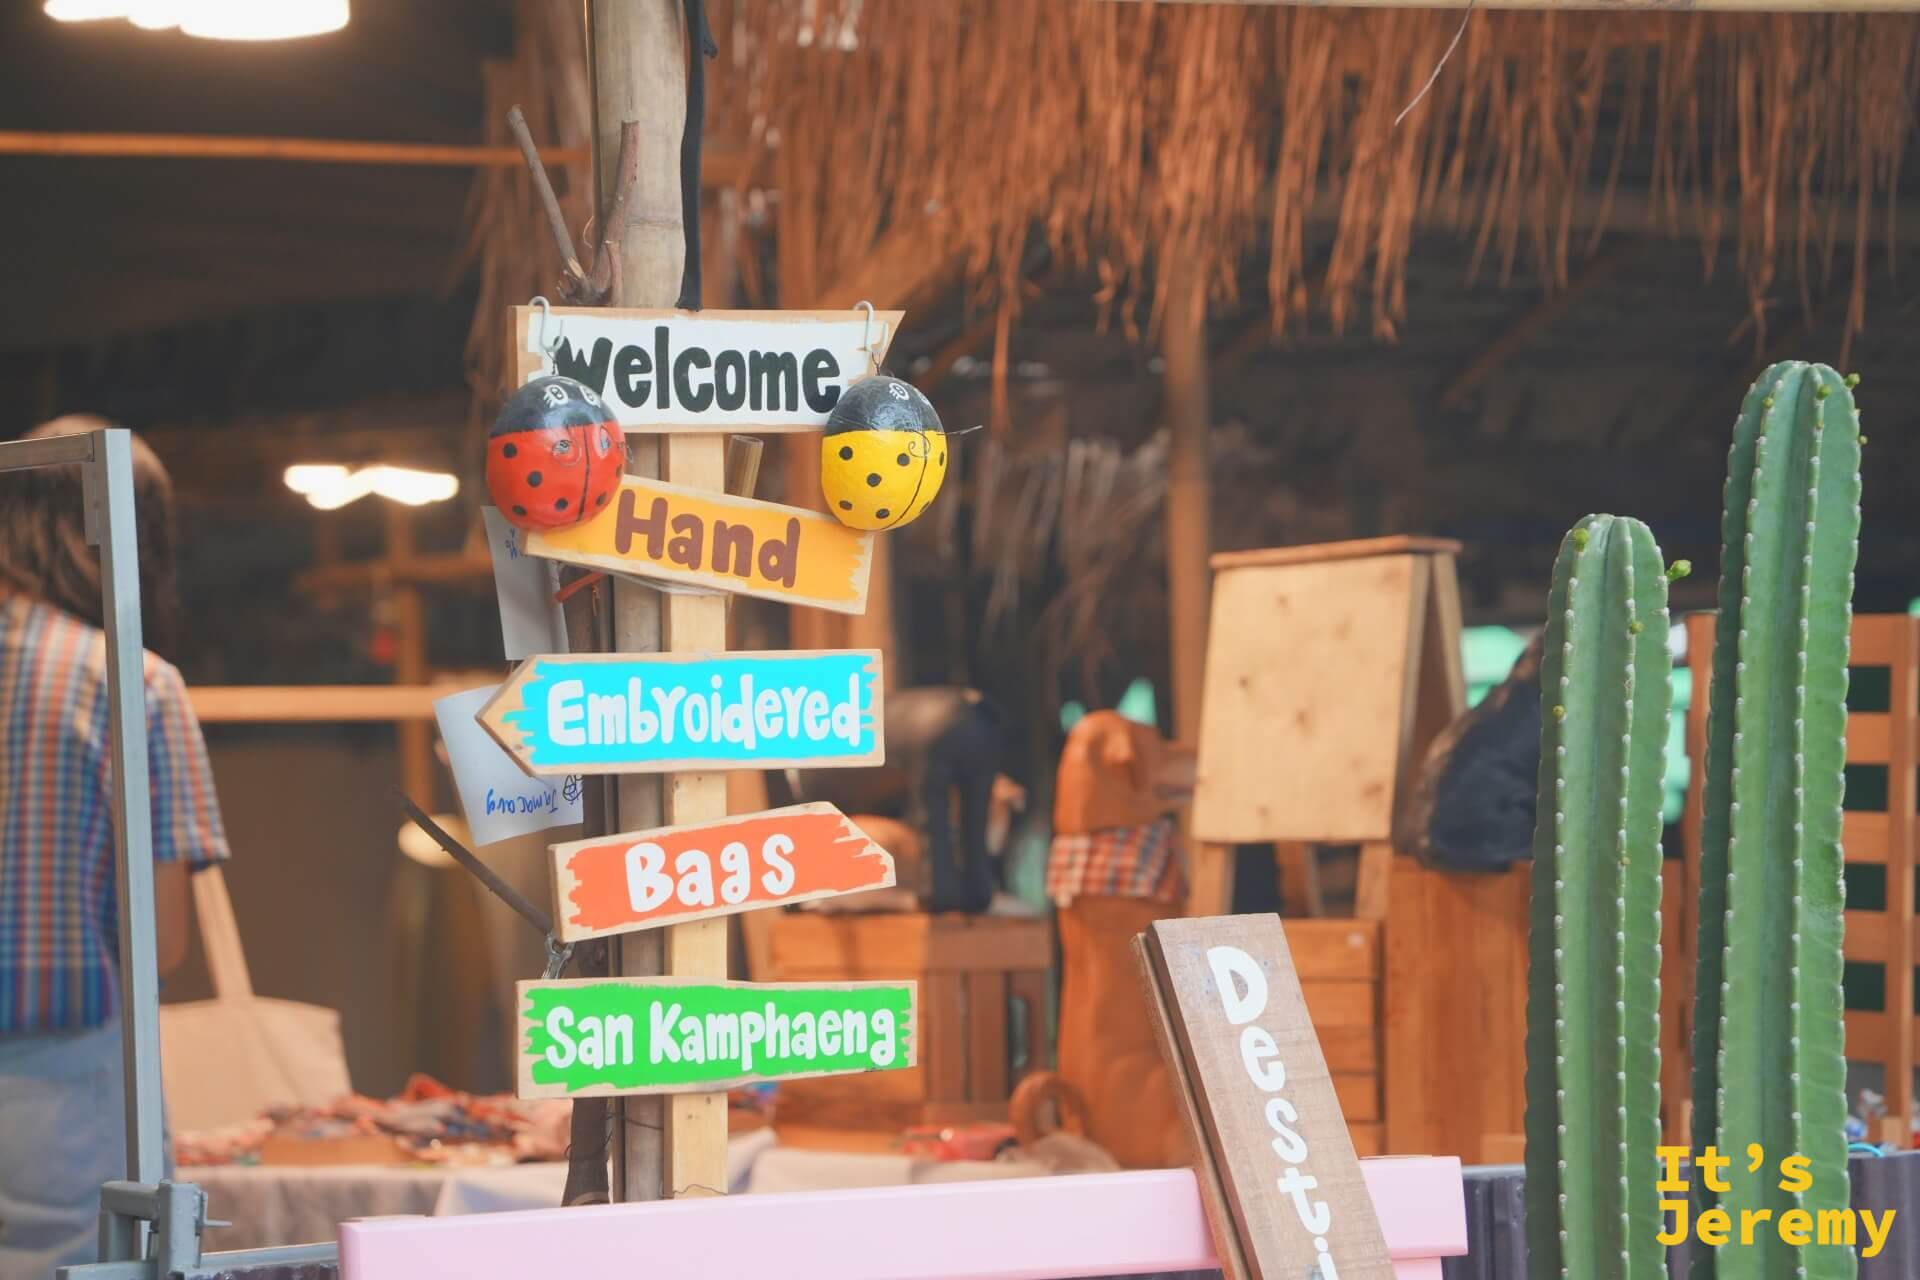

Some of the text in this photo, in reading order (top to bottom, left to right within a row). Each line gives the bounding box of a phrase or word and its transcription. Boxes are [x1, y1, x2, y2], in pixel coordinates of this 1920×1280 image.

[614, 489, 800, 588] Hand
[547, 674, 859, 749] Embroidered
[625, 834, 795, 912] Bags
[545, 1001, 896, 1071] San Kamphaeng
